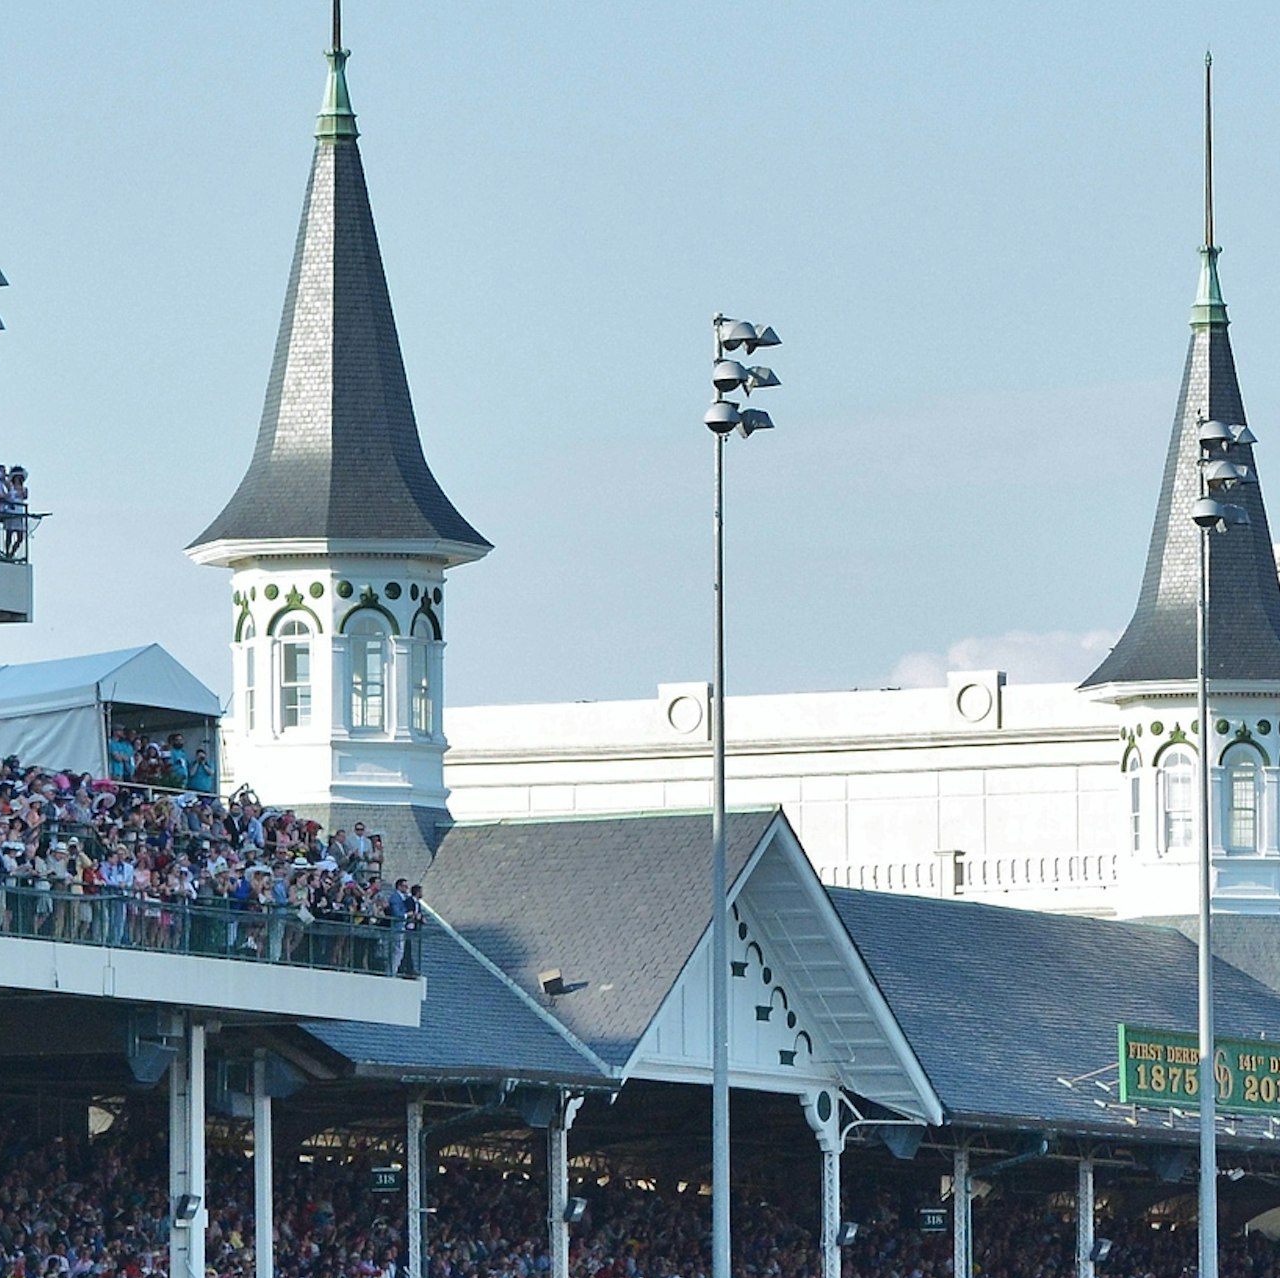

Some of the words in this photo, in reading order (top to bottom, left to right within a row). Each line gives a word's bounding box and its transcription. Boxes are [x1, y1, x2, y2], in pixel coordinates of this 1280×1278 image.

[1128, 1041, 1165, 1061] FIRST
[1166, 1045, 1201, 1066] DERB
[1136, 1063, 1199, 1096] 1875
[376, 1173, 395, 1185] 318
[924, 1215, 944, 1226] 318
